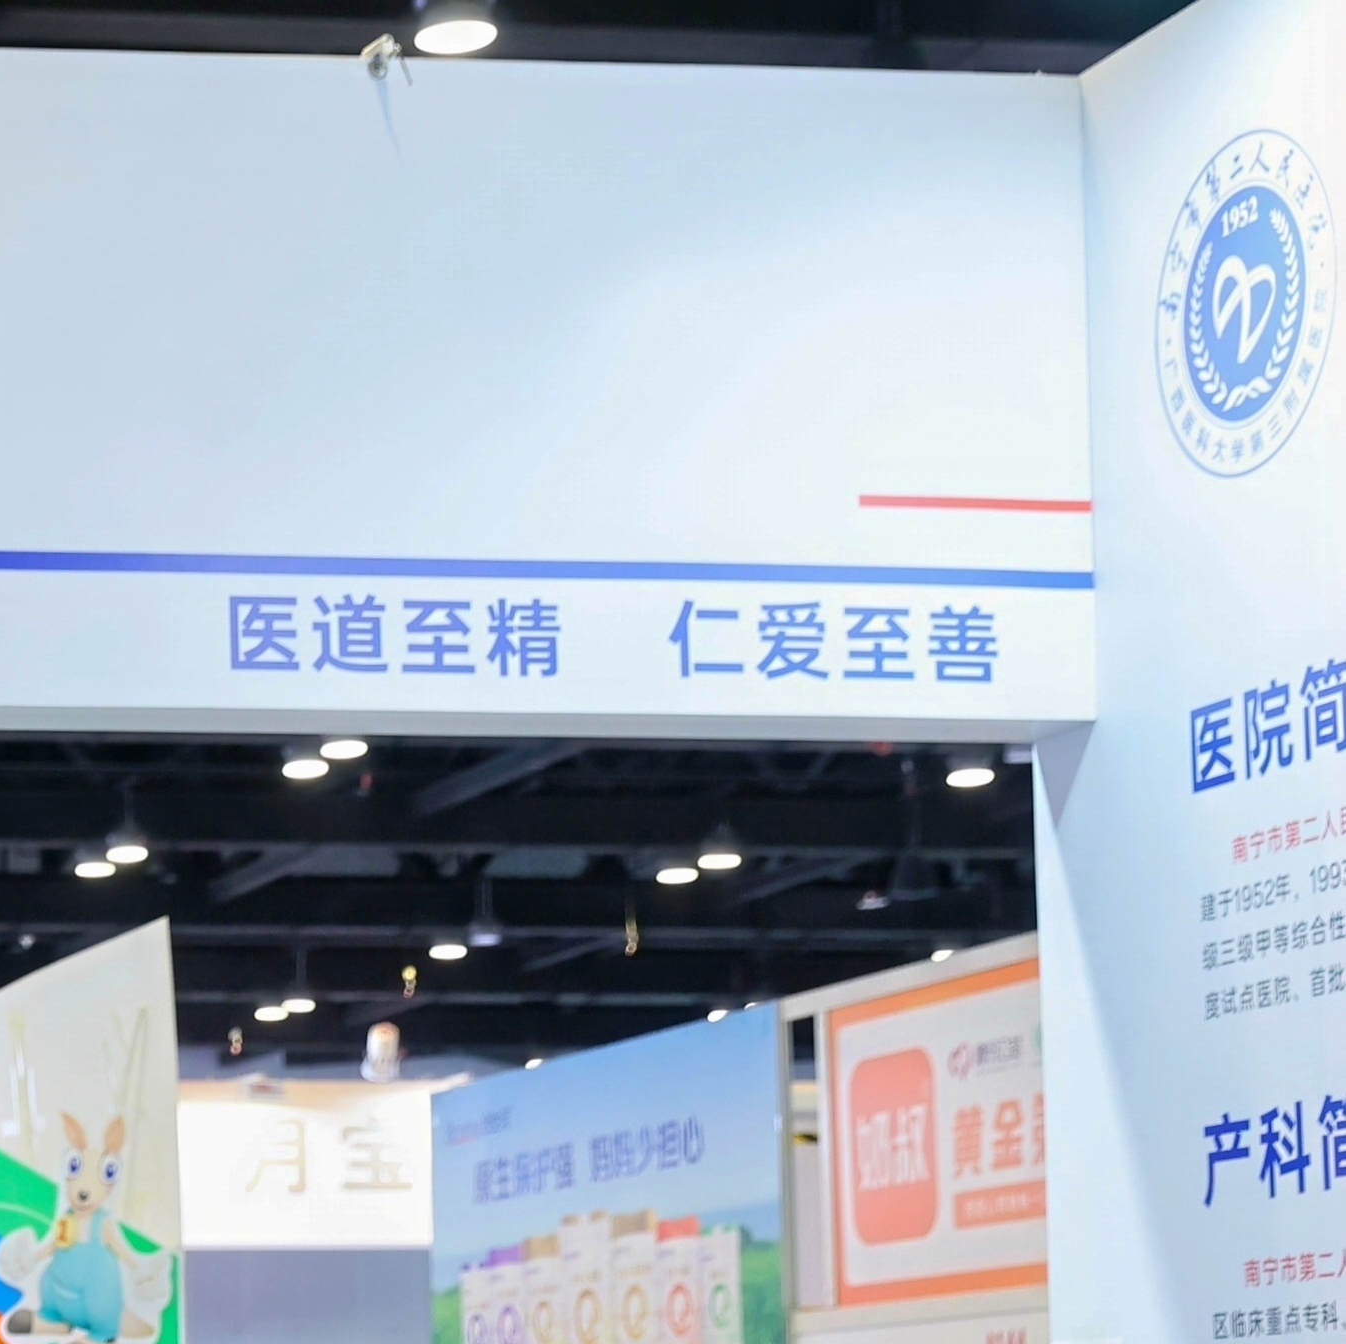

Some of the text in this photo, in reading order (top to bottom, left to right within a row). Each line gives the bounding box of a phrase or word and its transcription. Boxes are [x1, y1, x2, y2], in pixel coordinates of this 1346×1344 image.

[1219, 194, 1260, 239] 1952
[228, 594, 999, 683] 医道至精 仁爱至善
